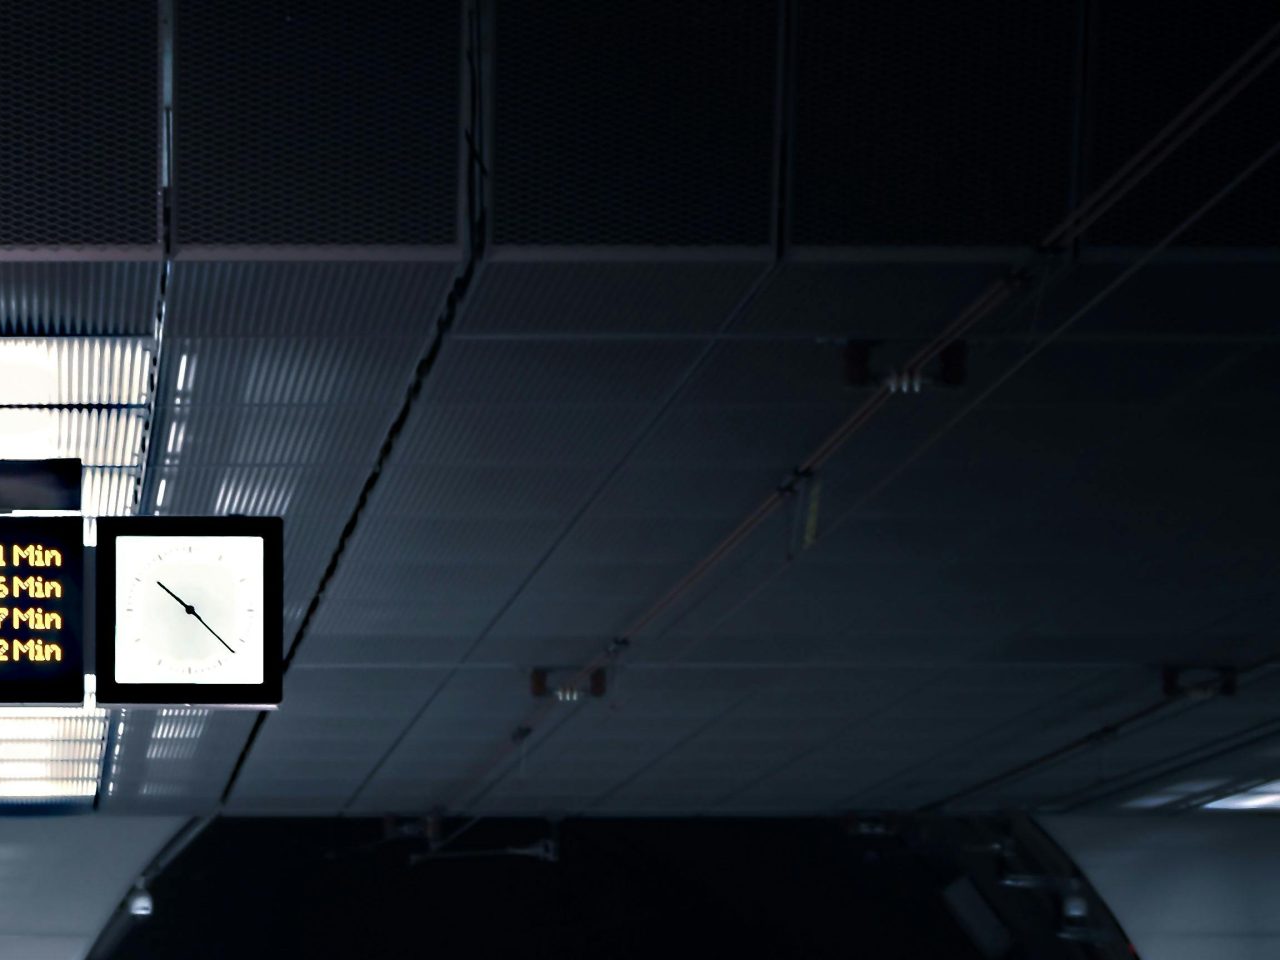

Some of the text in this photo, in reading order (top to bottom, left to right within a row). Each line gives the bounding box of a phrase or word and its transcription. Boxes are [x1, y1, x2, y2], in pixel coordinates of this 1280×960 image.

[12, 544, 62, 568] Min
[12, 576, 62, 600] Min
[12, 607, 62, 631] Min
[12, 638, 62, 662] Min
